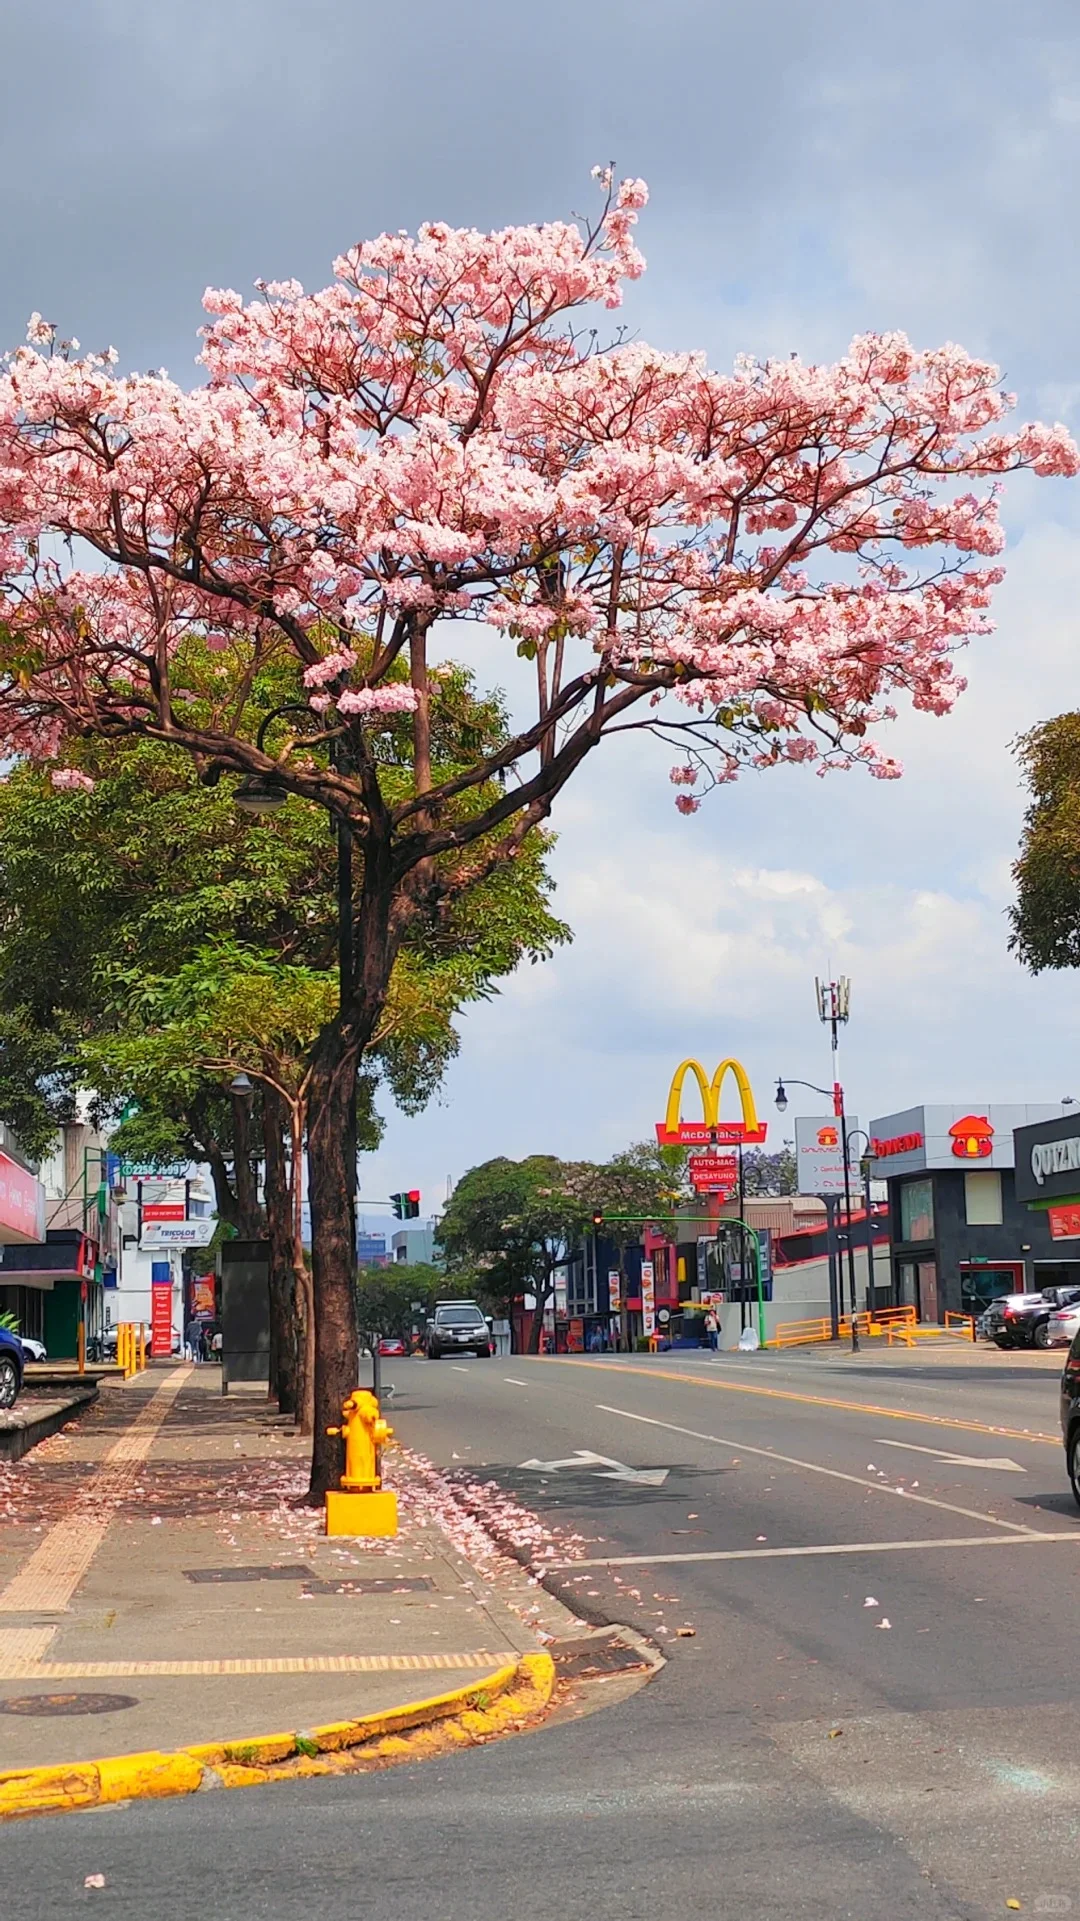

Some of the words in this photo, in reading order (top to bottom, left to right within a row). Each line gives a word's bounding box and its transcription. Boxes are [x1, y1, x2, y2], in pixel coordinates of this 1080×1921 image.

[693, 1158, 735, 1166] AUTO-MAC
[1031, 1137, 1080, 1185] QUIZN
[693, 1172, 735, 1181] DESAYUNO
